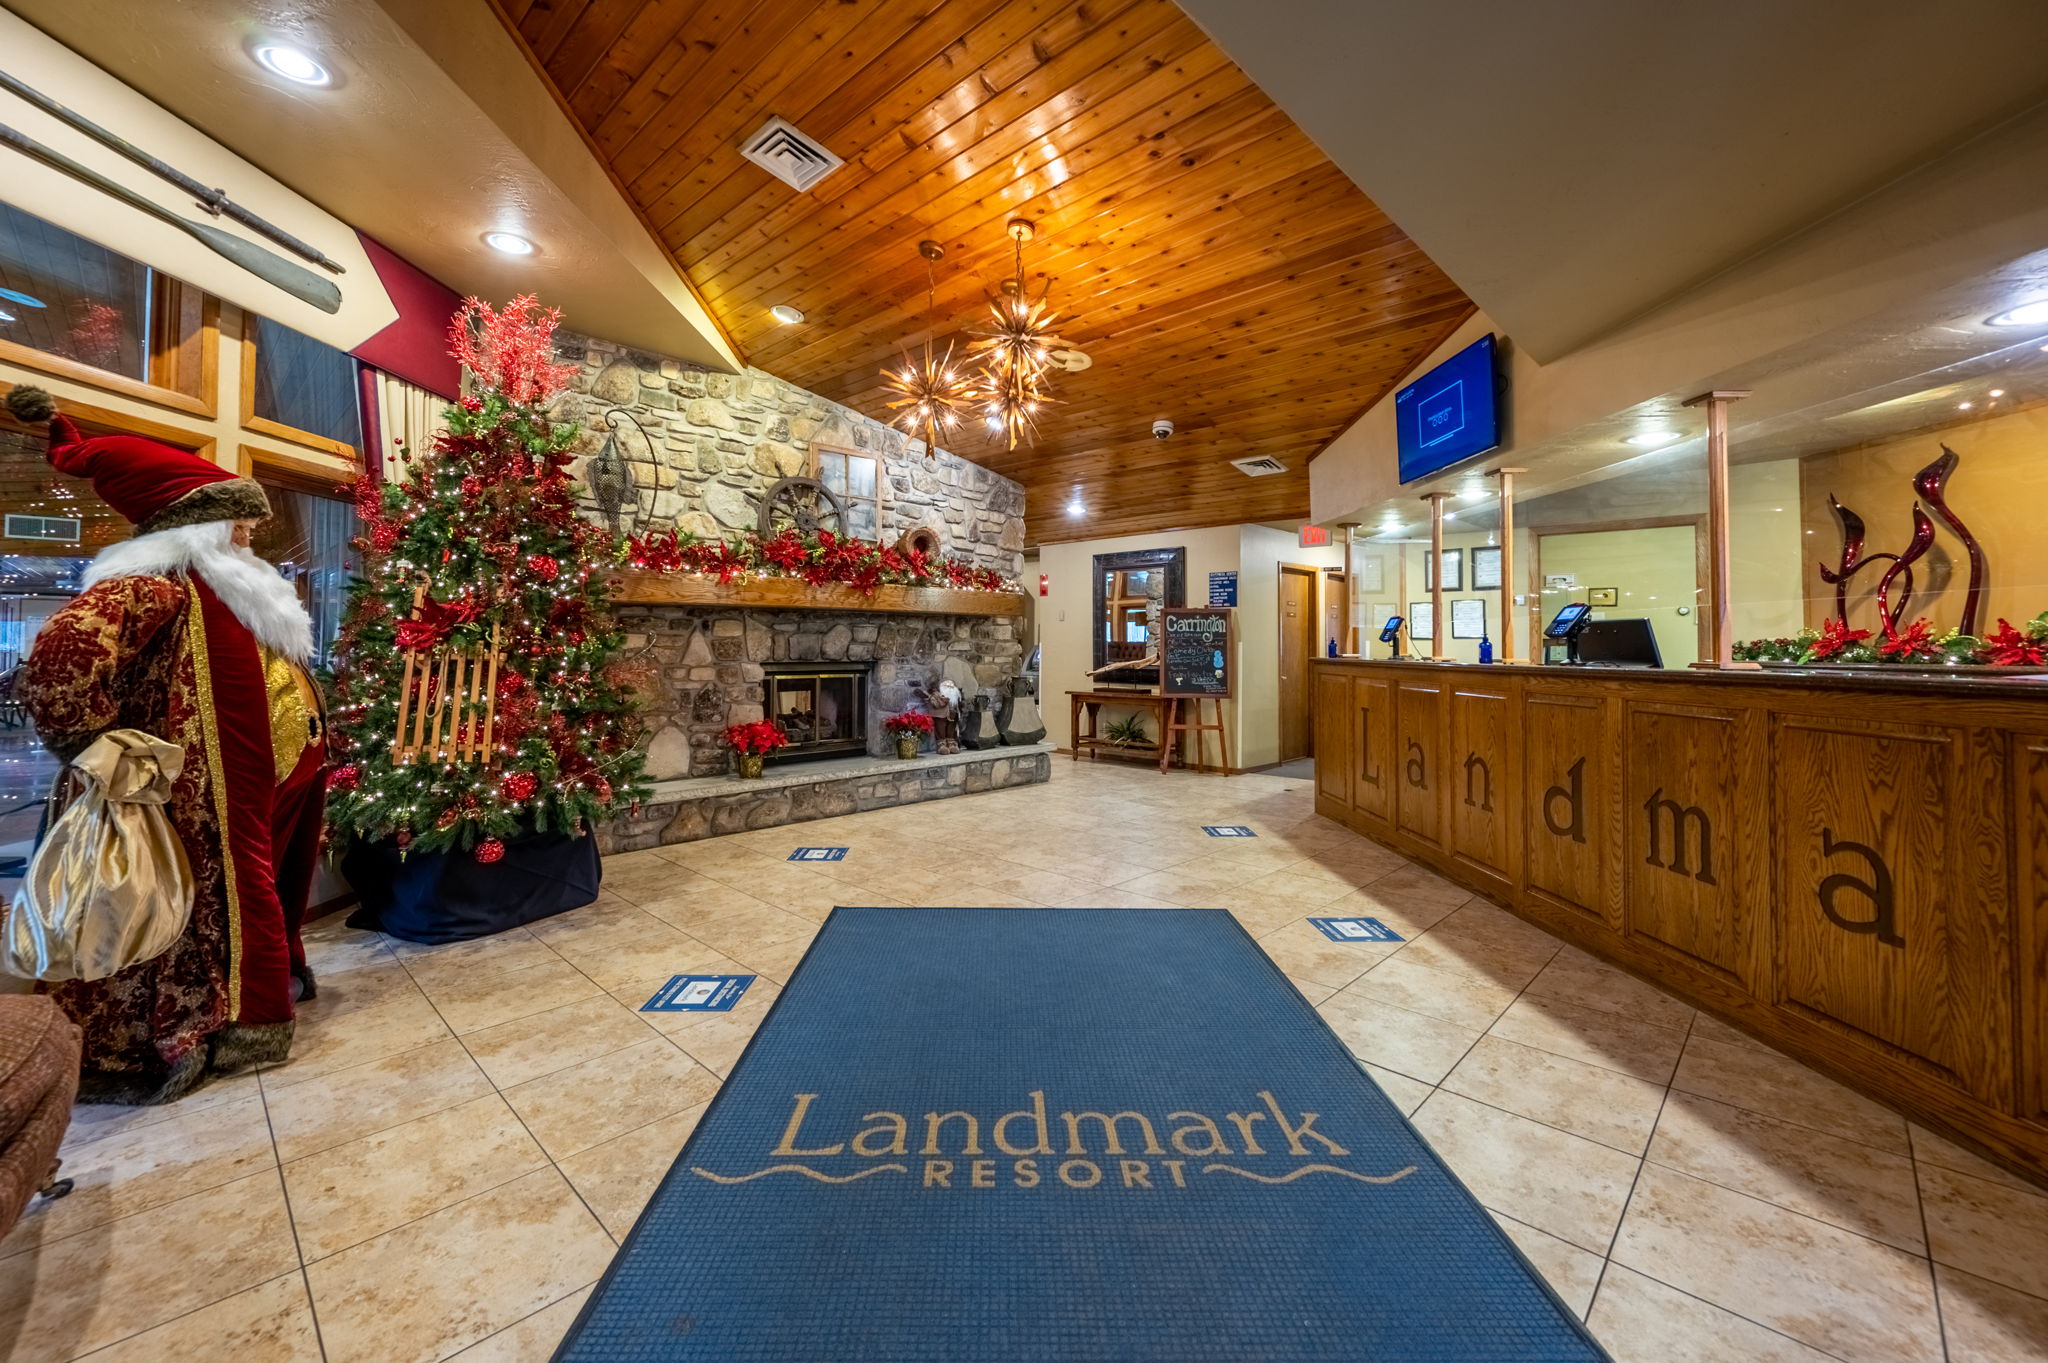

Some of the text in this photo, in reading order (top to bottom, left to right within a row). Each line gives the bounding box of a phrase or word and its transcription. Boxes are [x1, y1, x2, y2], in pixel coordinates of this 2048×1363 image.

[1303, 525, 1326, 545] EXIT
[1166, 615, 1226, 642] Carrington
[768, 1089, 1350, 1158] Landmark
[923, 1159, 1188, 1189] RESORT
